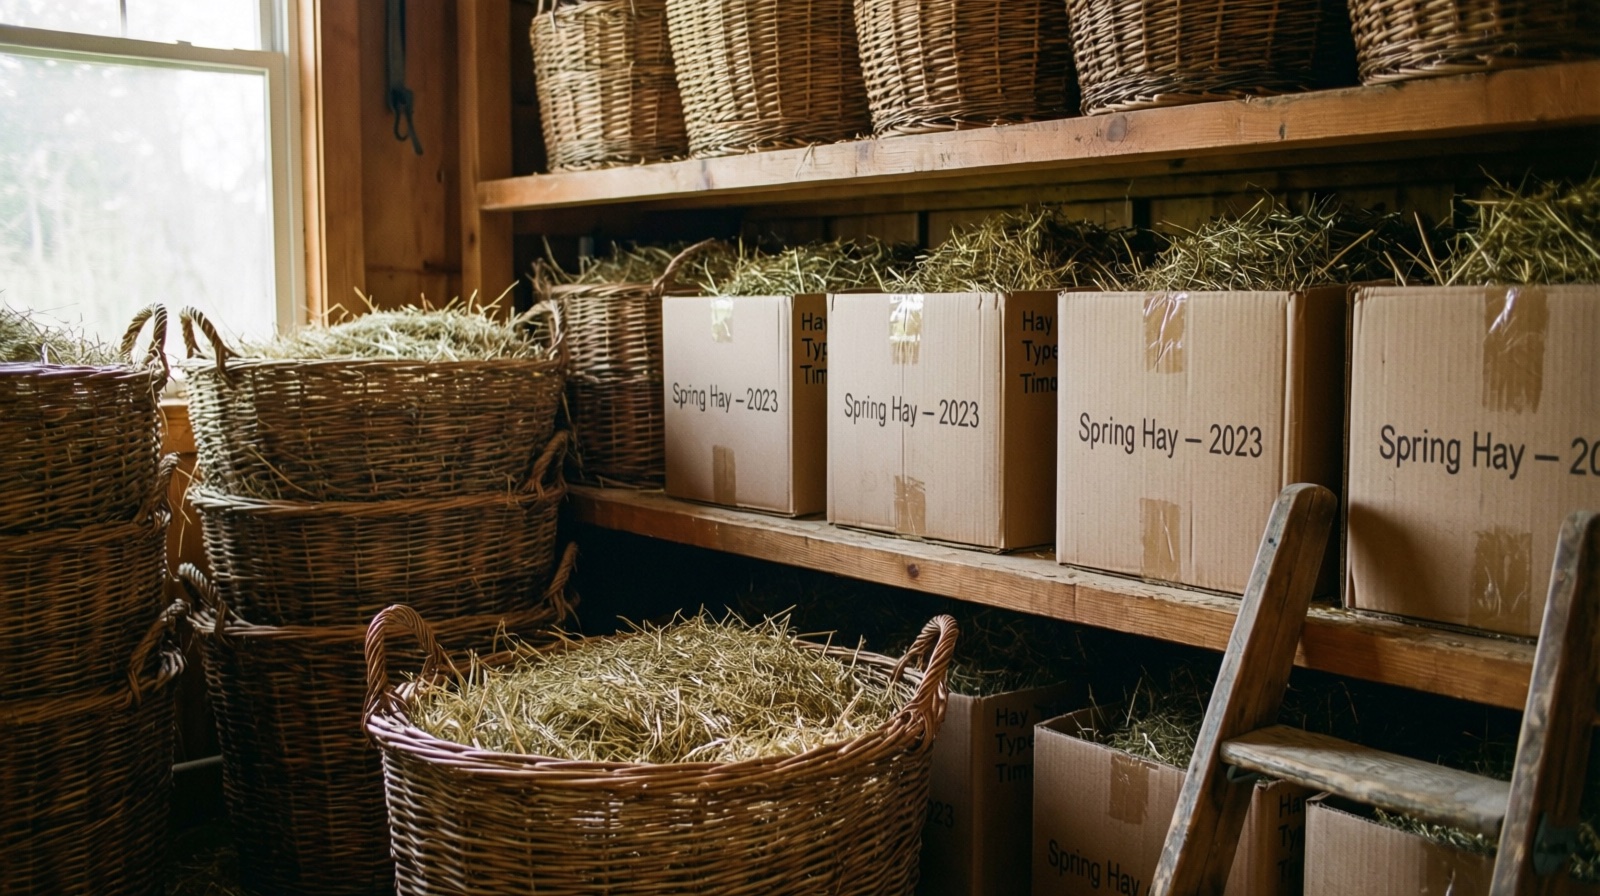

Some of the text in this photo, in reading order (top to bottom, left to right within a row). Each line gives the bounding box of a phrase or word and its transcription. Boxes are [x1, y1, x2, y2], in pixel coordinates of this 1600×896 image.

[1023, 310, 1052, 336] Hay
[710, 384, 732, 413] Hay
[746, 387, 779, 413] 2023
[844, 392, 886, 427] Spring
[891, 395, 918, 428] Hay
[939, 399, 980, 428] 2023
[1078, 412, 1135, 455] Spring
[1142, 417, 1179, 459] Hay
[1208, 423, 1263, 458] 2023
[1379, 424, 1461, 475] Spring
[1472, 430, 1526, 480] Hay
[996, 707, 1029, 729] Hay
[995, 763, 1033, 783] Tim
[926, 798, 954, 828] 023
[1279, 793, 1303, 818] Ha
[1047, 839, 1140, 896] Spring Hay
